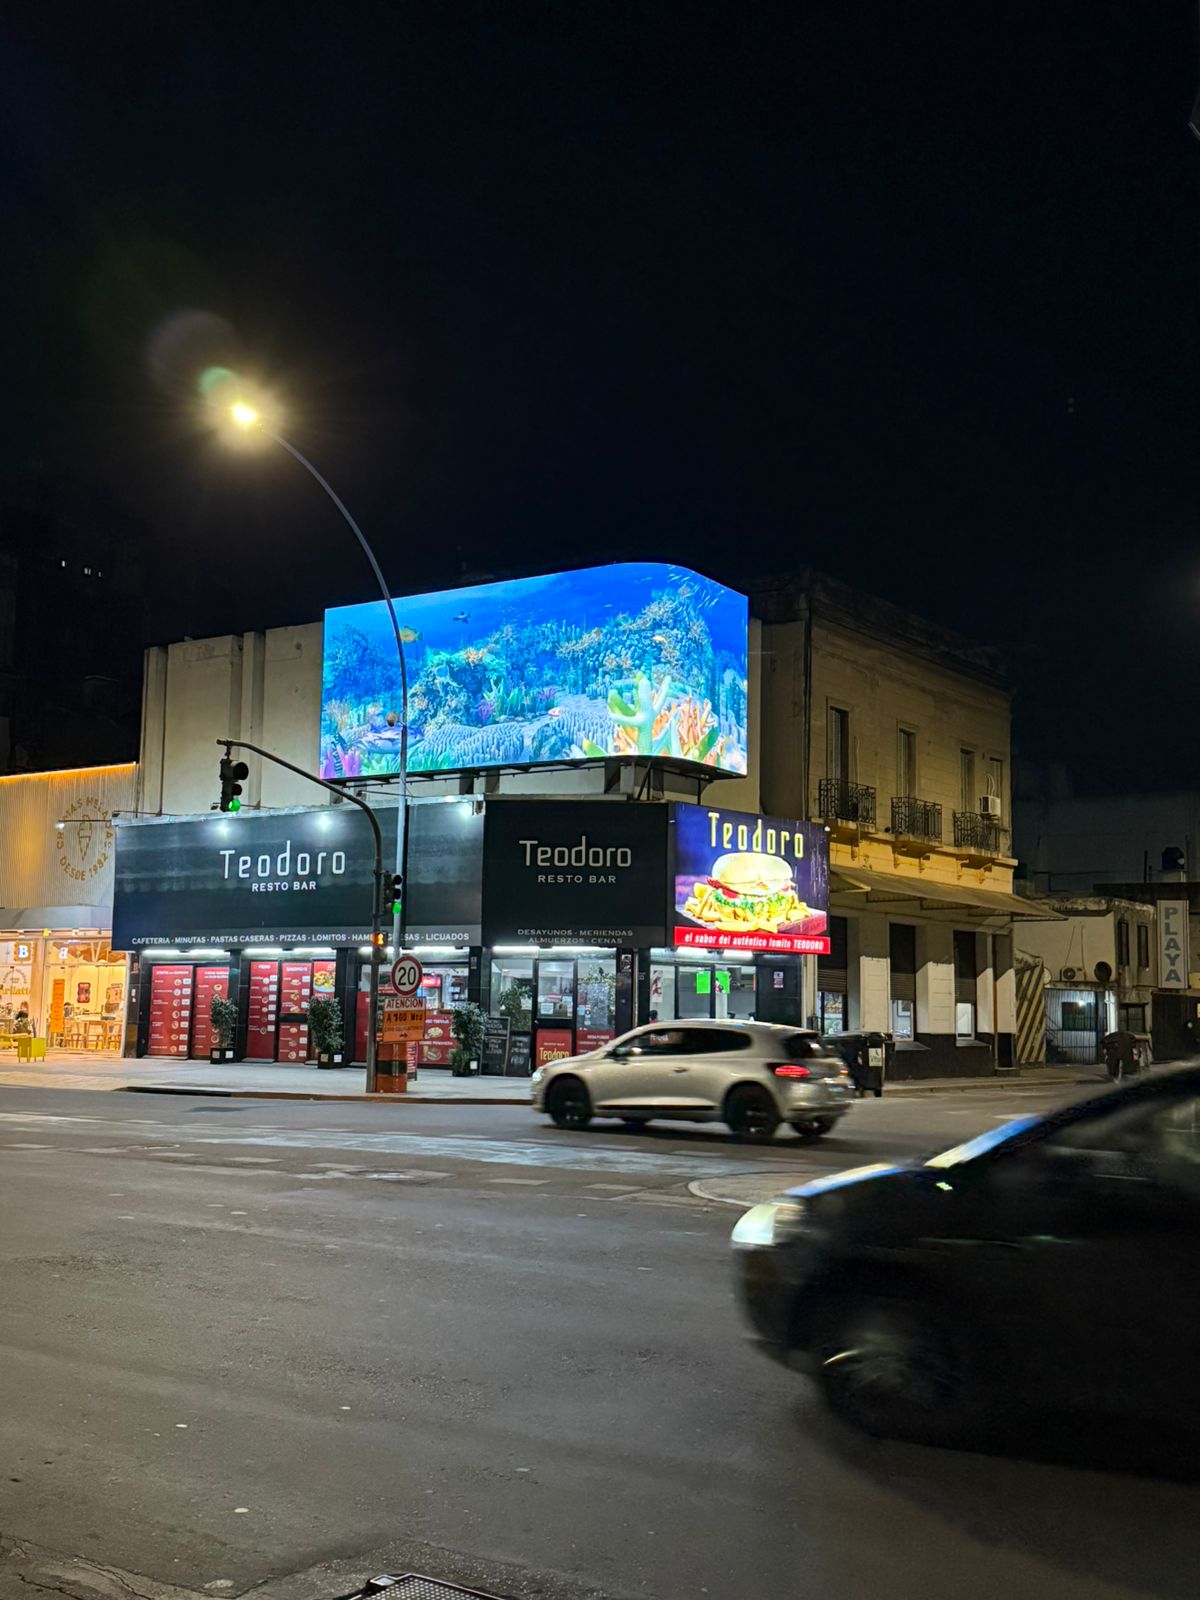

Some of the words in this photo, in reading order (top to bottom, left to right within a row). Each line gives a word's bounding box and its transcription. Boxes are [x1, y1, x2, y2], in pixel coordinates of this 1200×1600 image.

[707, 811, 804, 858] Teodoro
[219, 840, 345, 879] Teodoro
[519, 835, 632, 867] Teodoro
[251, 881, 289, 892] RESTO
[293, 880, 317, 890] BAR
[538, 874, 583, 883] RESTO
[589, 875, 617, 883] BAR
[131, 937, 171, 945] CAFETERIA
[174, 936, 207, 944] MINUTAS
[210, 935, 238, 944] PASTAS
[239, 934, 275, 943] CASERAS
[279, 934, 307, 942] PIZZAS
[311, 933, 347, 942] LOMITOS
[425, 932, 470, 941] LICUADOS
[517, 928, 573, 936] DESAYUNOS
[580, 929, 633, 937] MERIENDAS
[591, 937, 623, 945] CENAS
[684, 932, 693, 943] el
[695, 932, 717, 944] sabor
[718, 934, 731, 945] del
[732, 934, 767, 947] auténtico
[768, 937, 791, 949] lomito
[793, 939, 825, 951] TEODORO
[1164, 906, 1182, 983] PLAYA
[397, 966, 417, 986] 20
